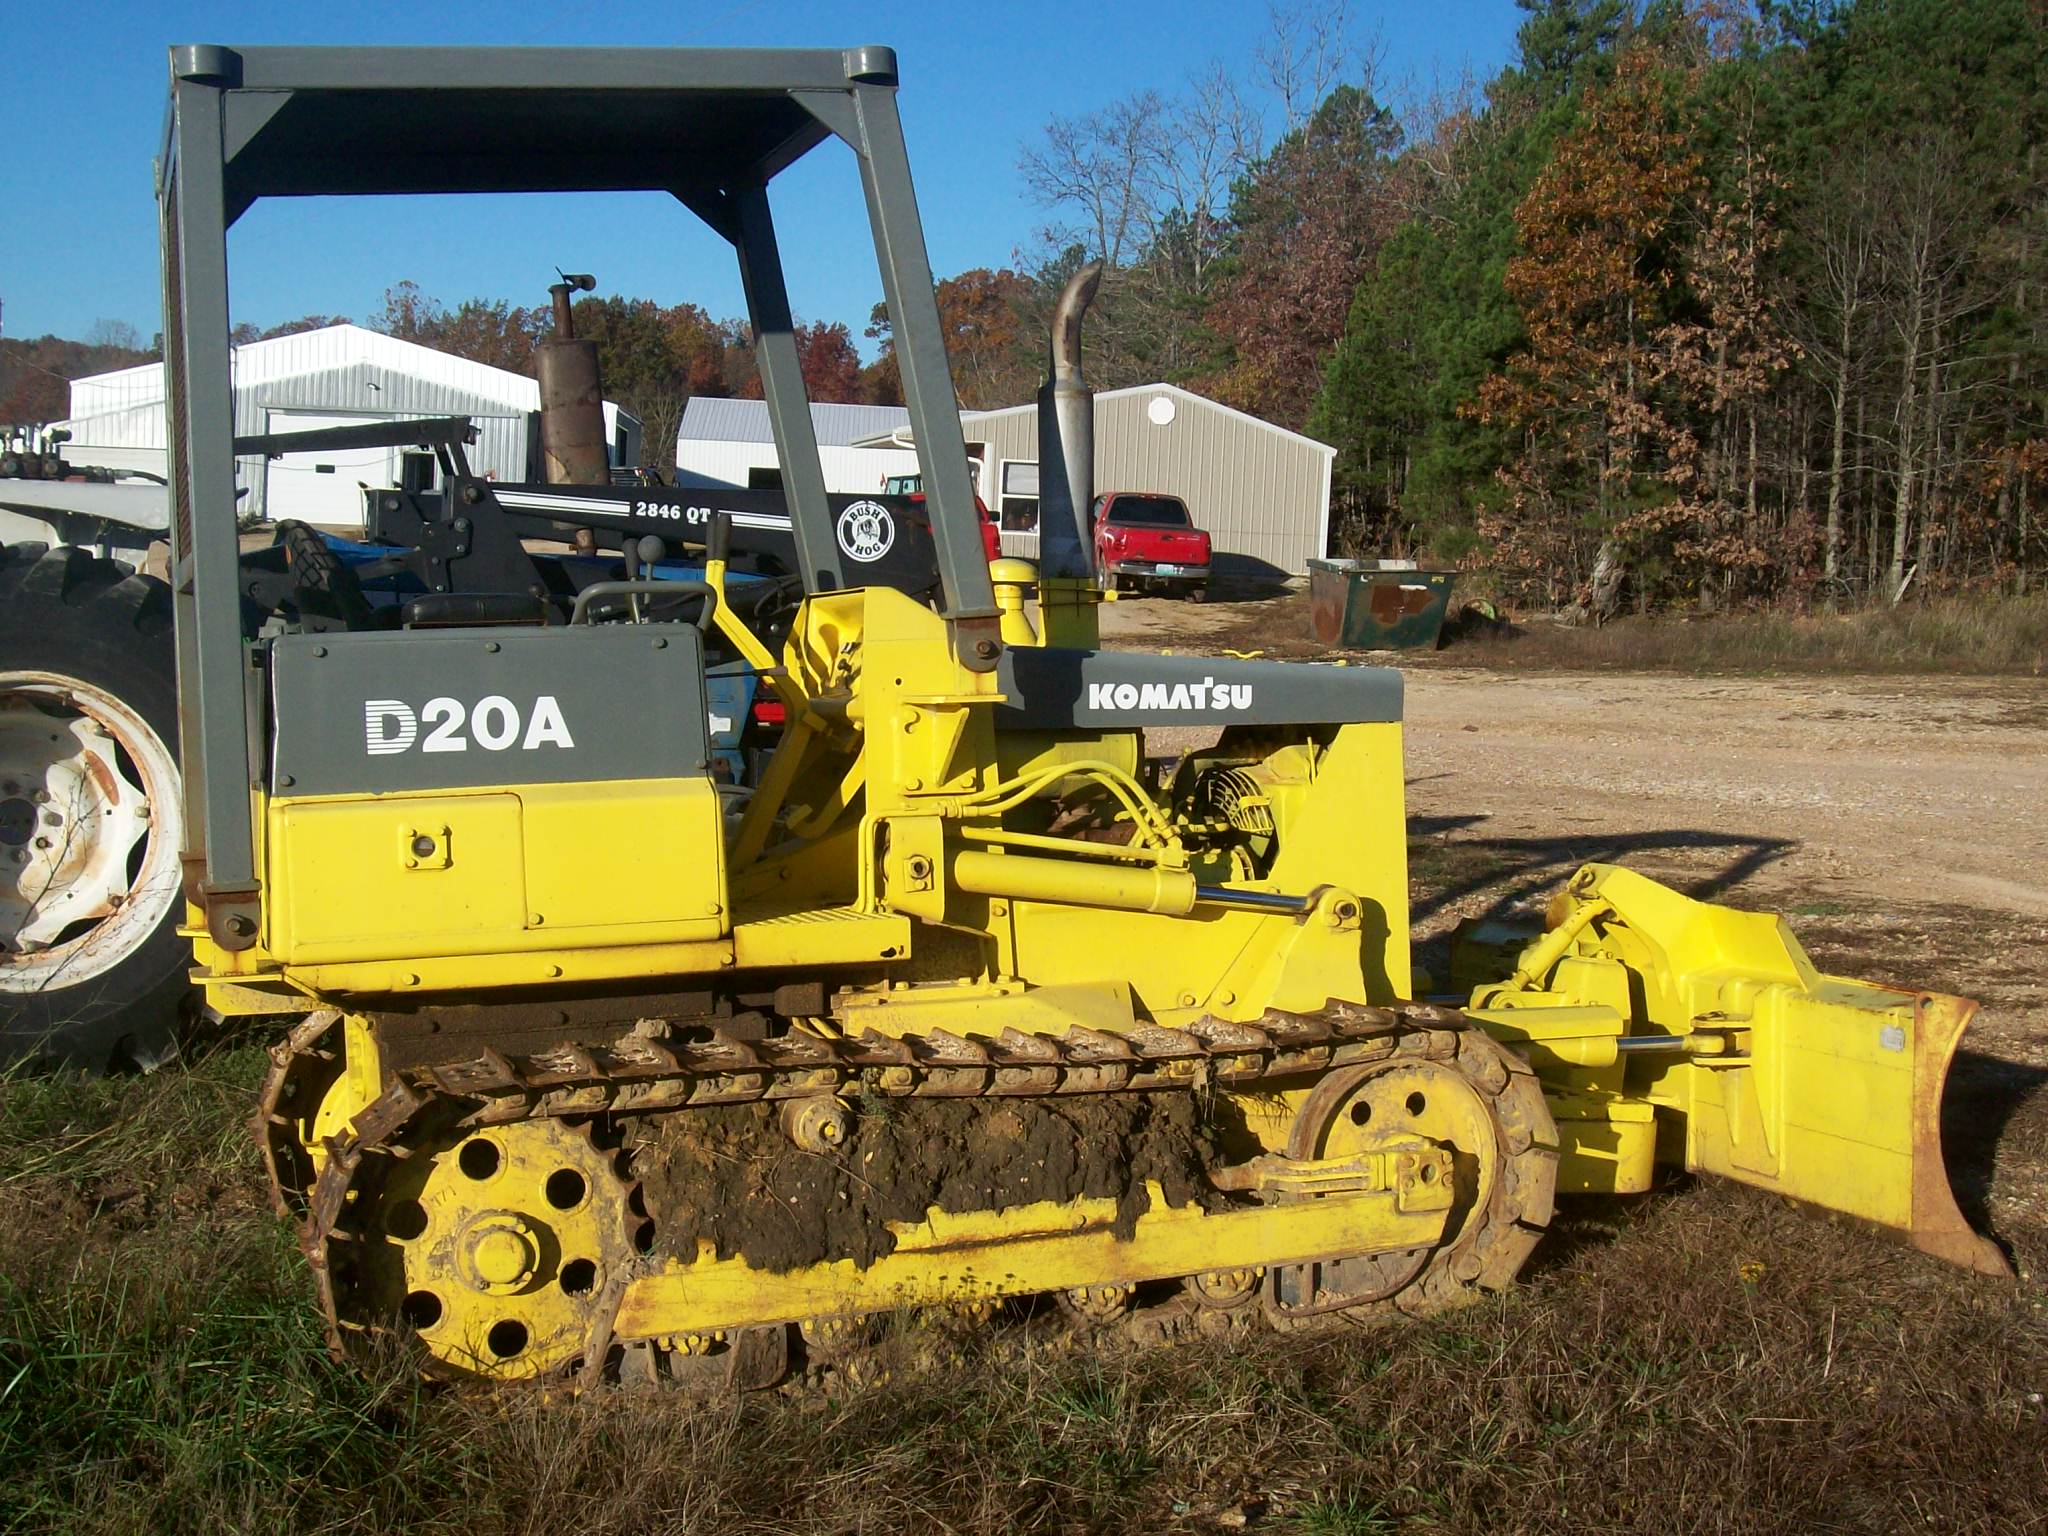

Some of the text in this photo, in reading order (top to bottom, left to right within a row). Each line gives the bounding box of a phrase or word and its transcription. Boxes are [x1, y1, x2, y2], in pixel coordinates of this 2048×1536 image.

[635, 501, 711, 524] 2846 QT
[849, 506, 881, 521] BUSH
[855, 543, 881, 555] HOG
[1088, 676, 1253, 710] KOMATSU
[365, 695, 576, 755] D20A
